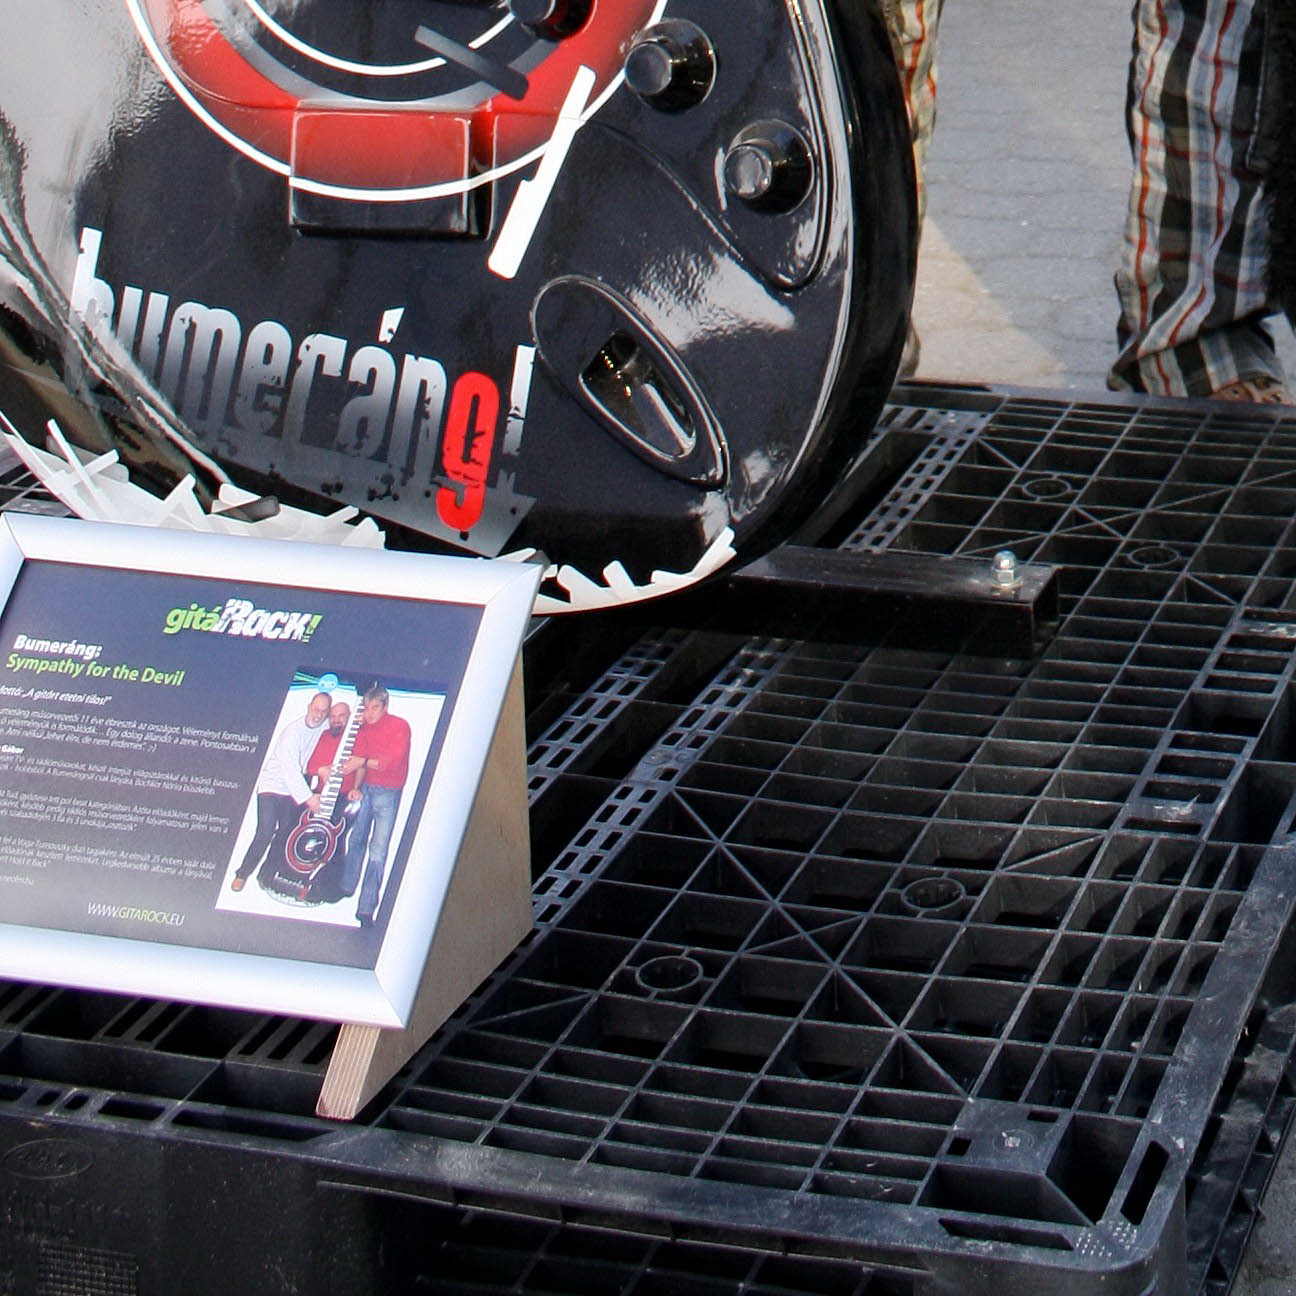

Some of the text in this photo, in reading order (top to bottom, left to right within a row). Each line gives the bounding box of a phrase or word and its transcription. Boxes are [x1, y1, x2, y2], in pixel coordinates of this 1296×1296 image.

[13, 634, 103, 660] Bumeráng:
[6, 653, 185, 686] Sympathy for the Devil
